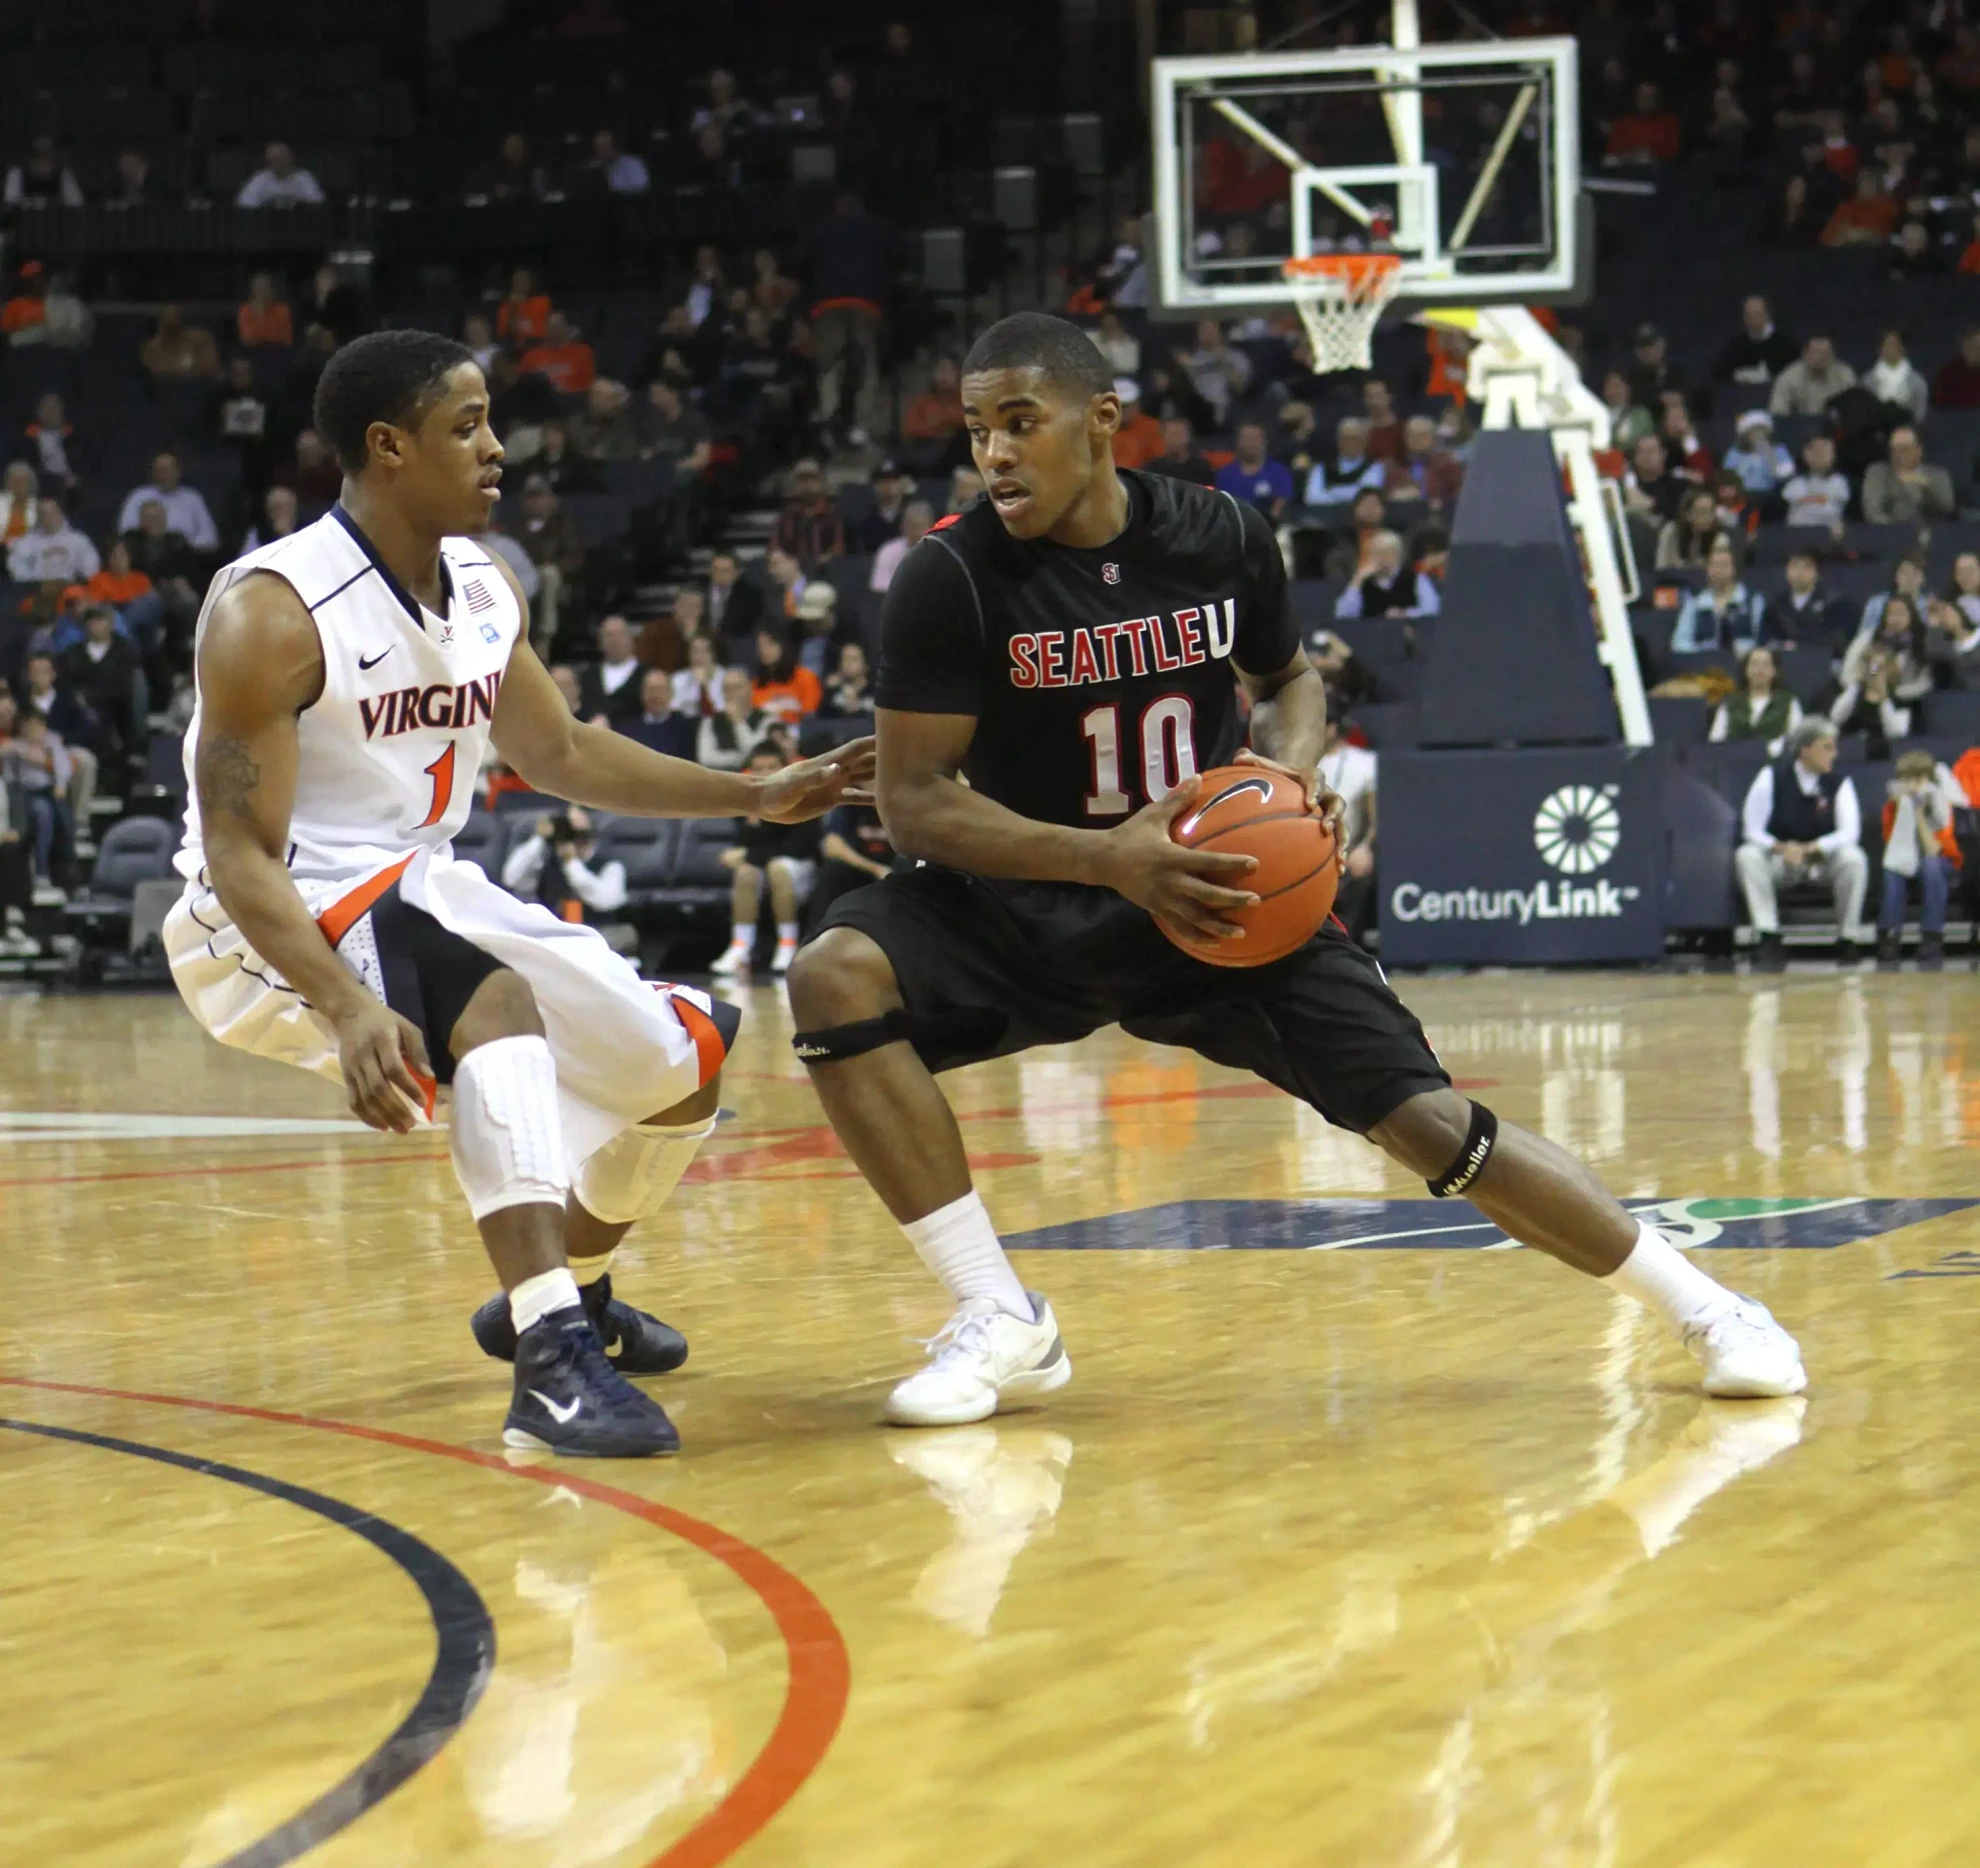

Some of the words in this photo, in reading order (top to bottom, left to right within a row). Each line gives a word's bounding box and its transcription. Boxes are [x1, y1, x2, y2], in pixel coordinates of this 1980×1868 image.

[411, 740, 456, 831] 1
[1080, 693, 1199, 815] 10
[1391, 877, 1622, 927] CenturyLink
